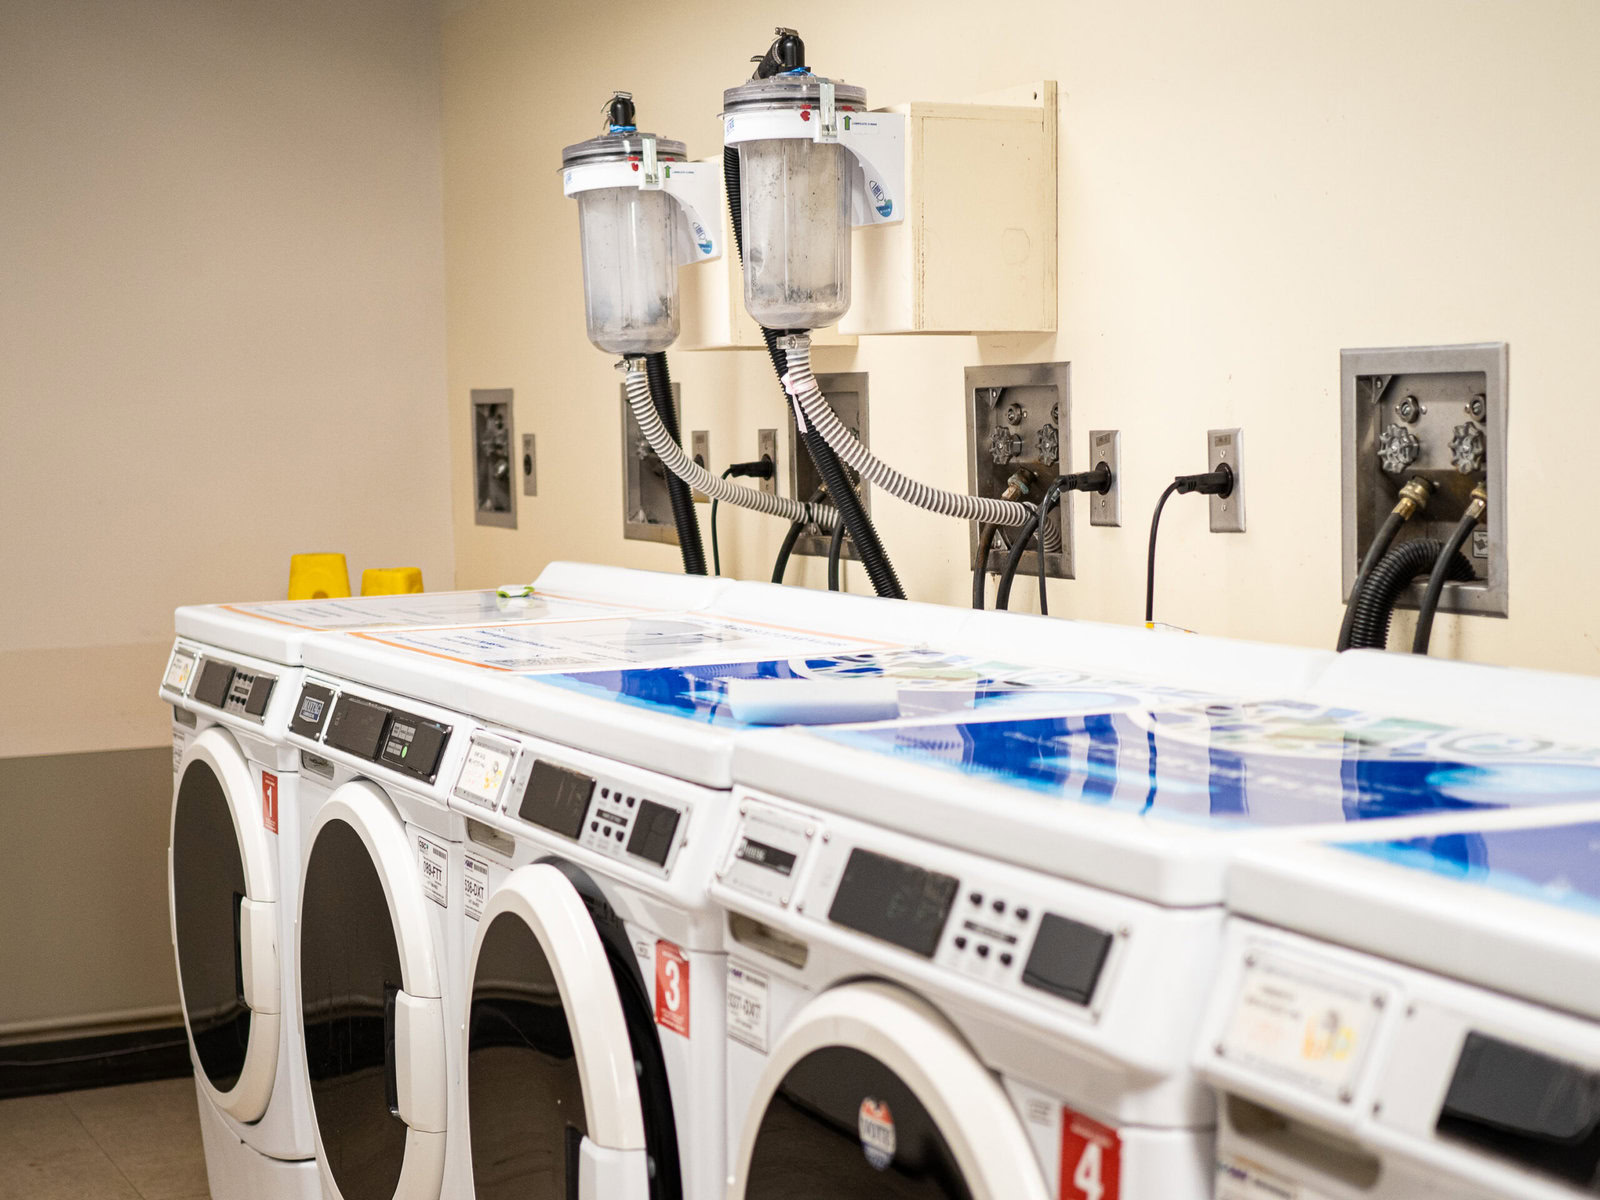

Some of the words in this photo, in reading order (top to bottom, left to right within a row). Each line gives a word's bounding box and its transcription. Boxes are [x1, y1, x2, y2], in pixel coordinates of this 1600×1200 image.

[266, 785, 273, 817] 1
[664, 960, 680, 1012] 3
[1073, 1141, 1105, 1200] 4
